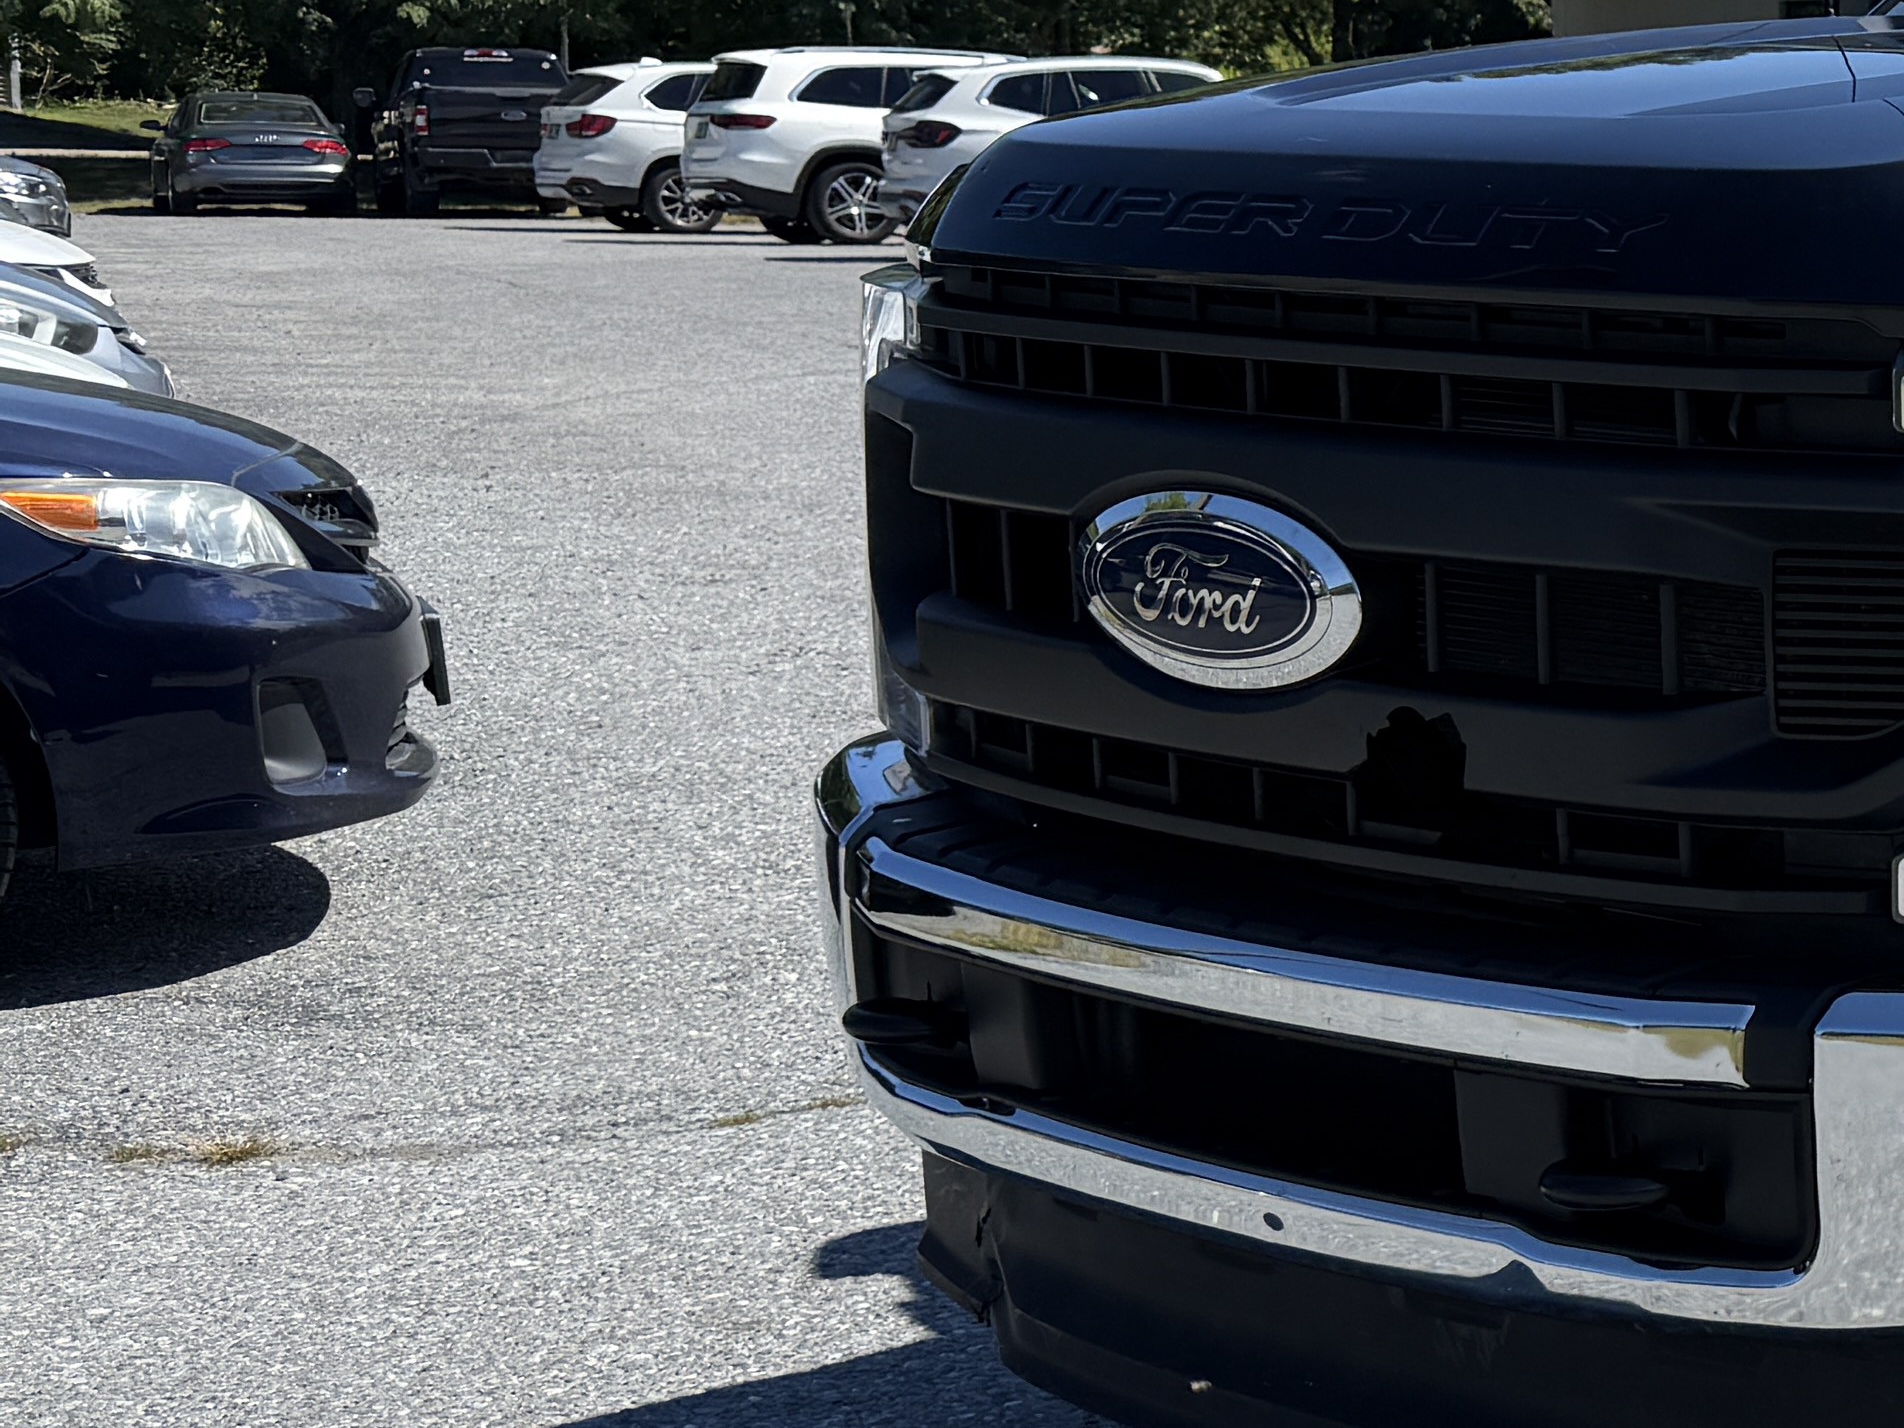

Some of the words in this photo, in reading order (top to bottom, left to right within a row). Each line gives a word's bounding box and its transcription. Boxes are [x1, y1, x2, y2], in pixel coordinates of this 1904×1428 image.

[993, 182, 1313, 237] SUPER
[1321, 201, 1668, 253] DUTY
[1134, 543, 1263, 635] Ford
